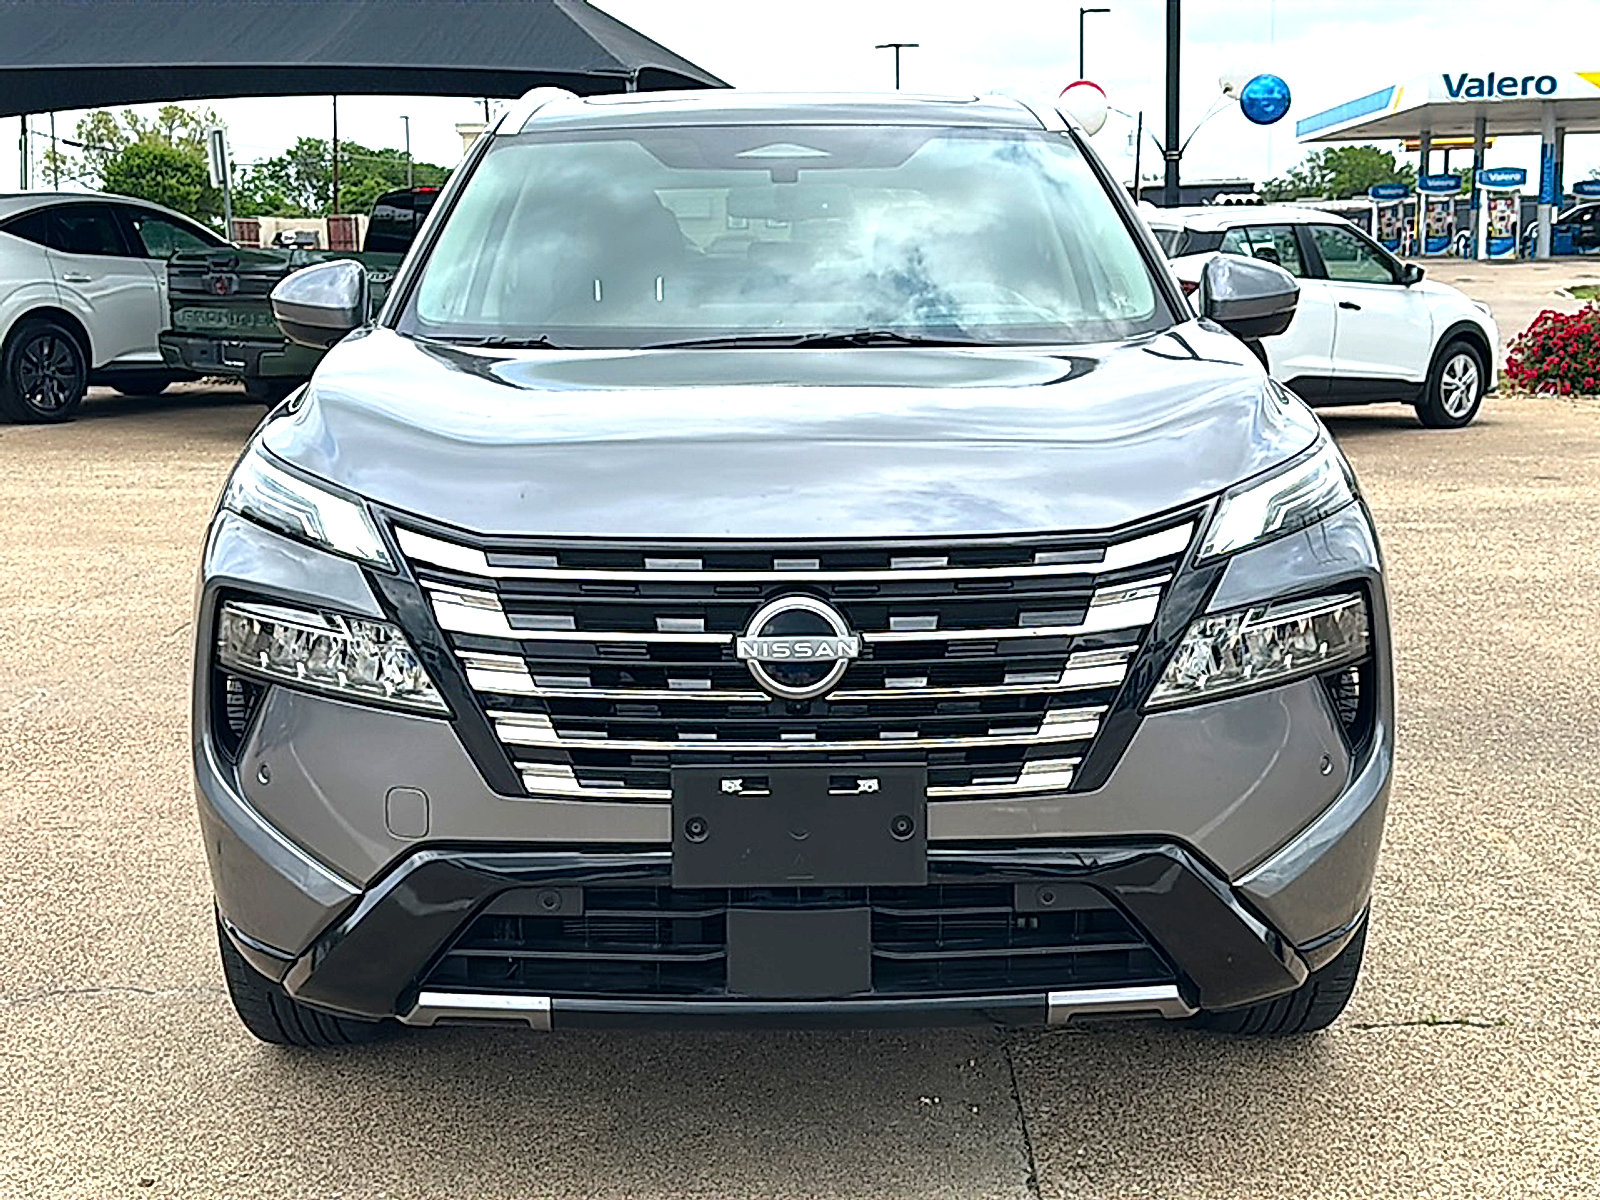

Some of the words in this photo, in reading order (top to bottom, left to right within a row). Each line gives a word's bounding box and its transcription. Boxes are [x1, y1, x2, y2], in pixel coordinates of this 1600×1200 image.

[1442, 72, 1557, 97] Valero
[1488, 173, 1521, 181] Valero
[741, 641, 856, 657] NISSAN
